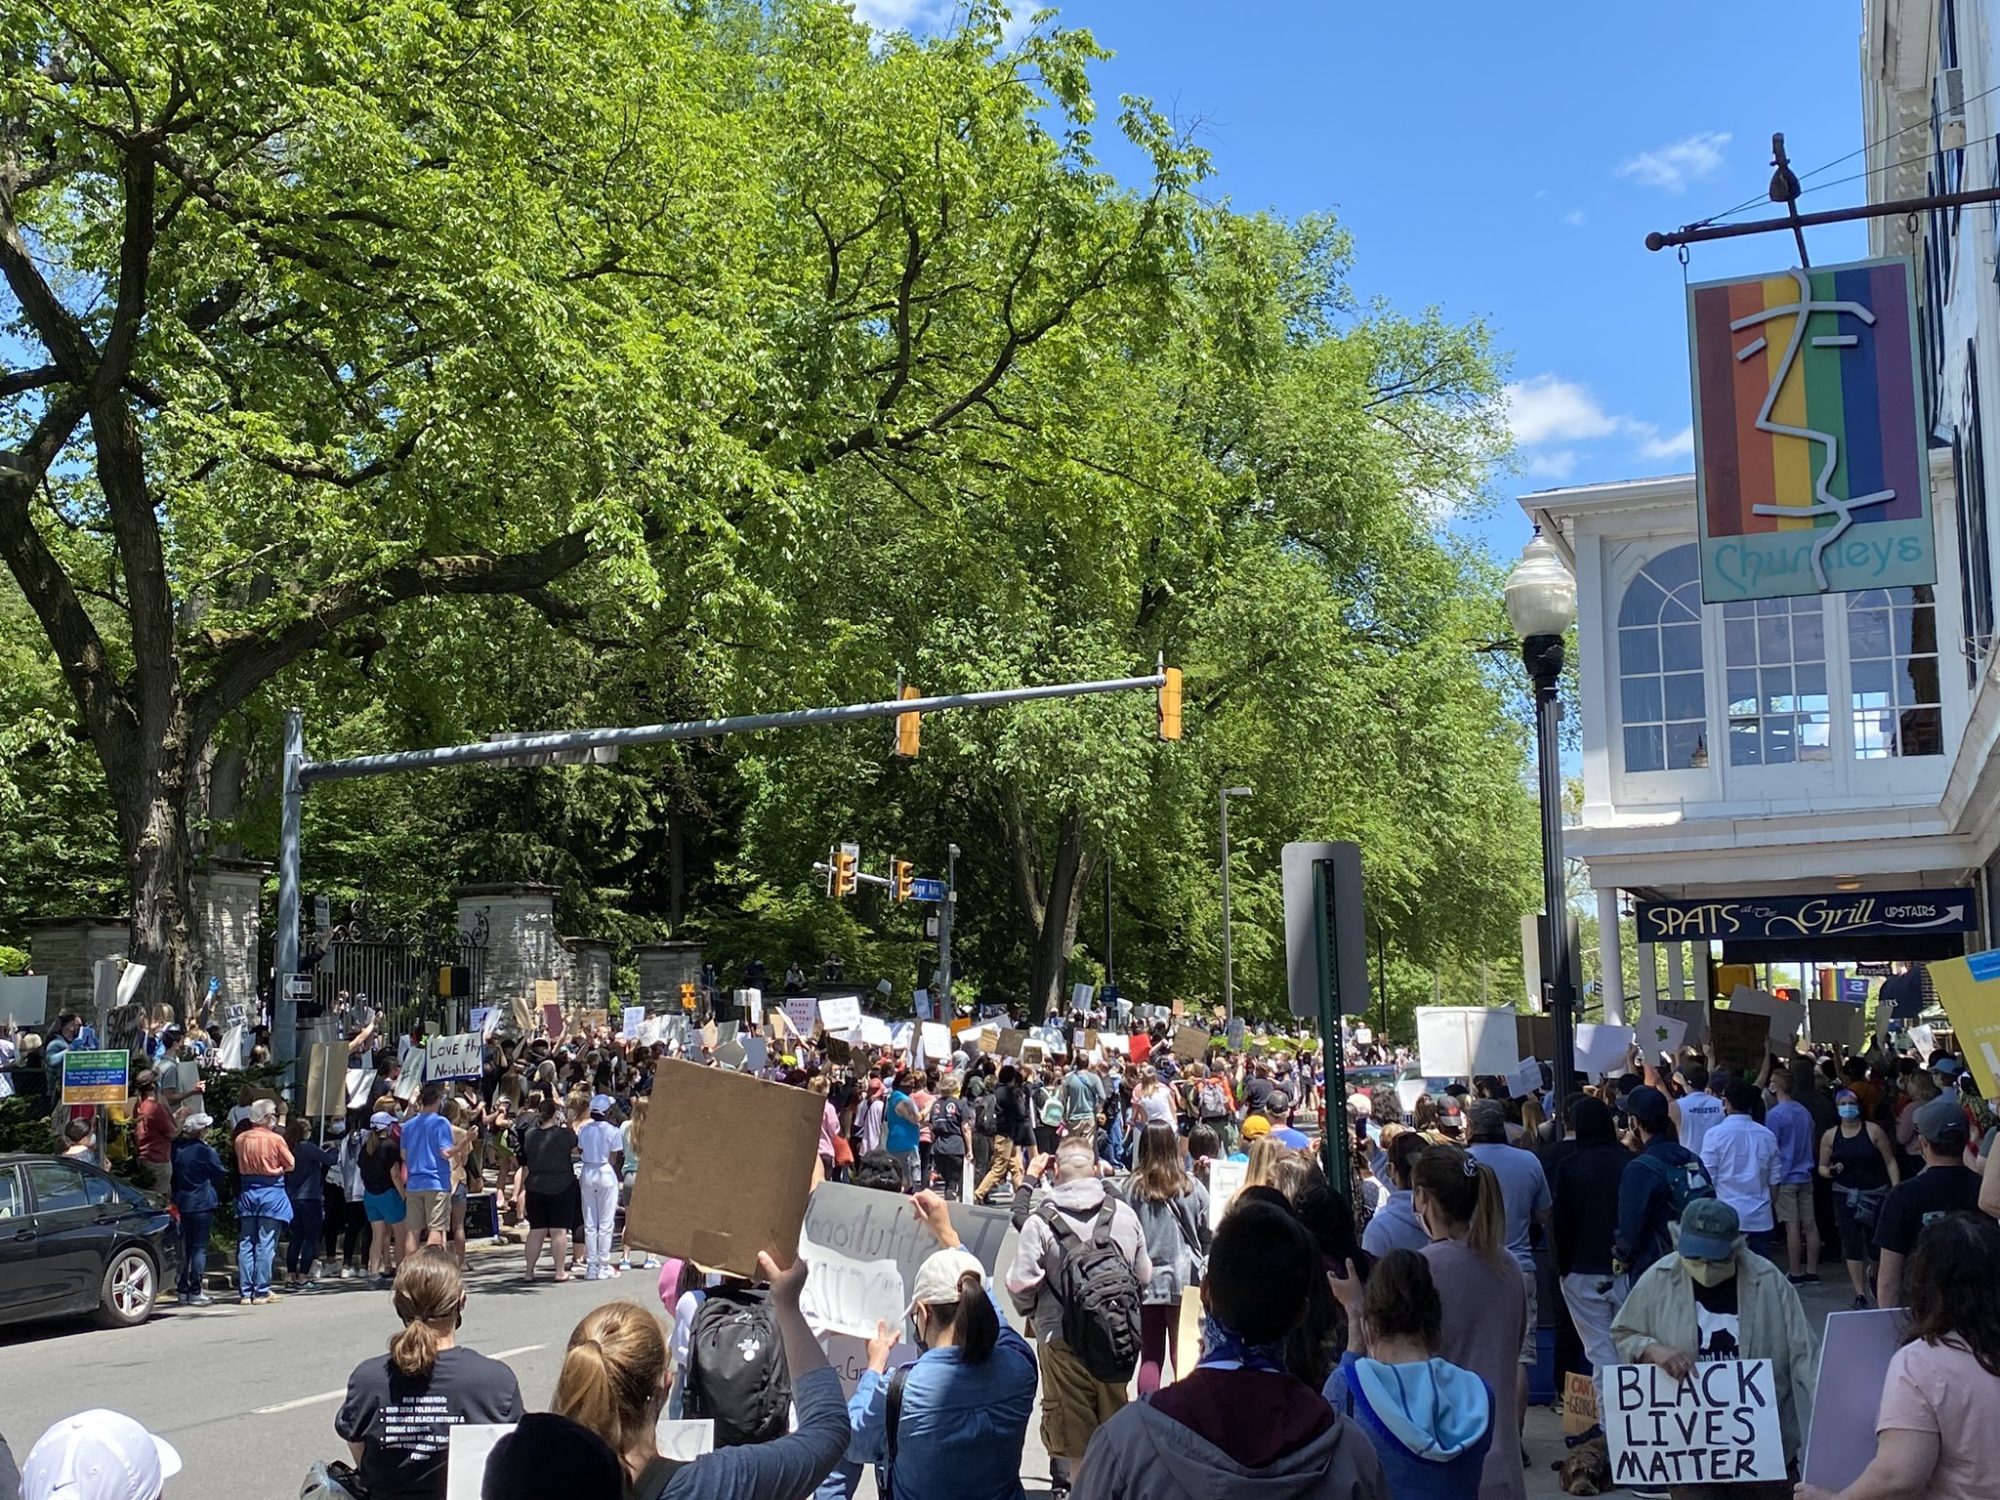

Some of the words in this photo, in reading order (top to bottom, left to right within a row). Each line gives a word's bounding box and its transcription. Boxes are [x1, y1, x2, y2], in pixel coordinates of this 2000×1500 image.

[1648, 904, 1740, 935] SPATS
[1741, 905, 1752, 913] at
[1797, 898, 1876, 934] Grill
[1885, 905, 1936, 918] UPSTAIRS
[429, 1042, 460, 1060] LOVE
[464, 1038, 482, 1058] thy
[434, 1061, 480, 1078] Neighbor
[1617, 1360, 1766, 1411] BLACK
[1625, 1406, 1756, 1447] LIVES
[1616, 1448, 1759, 1483] MATTER
